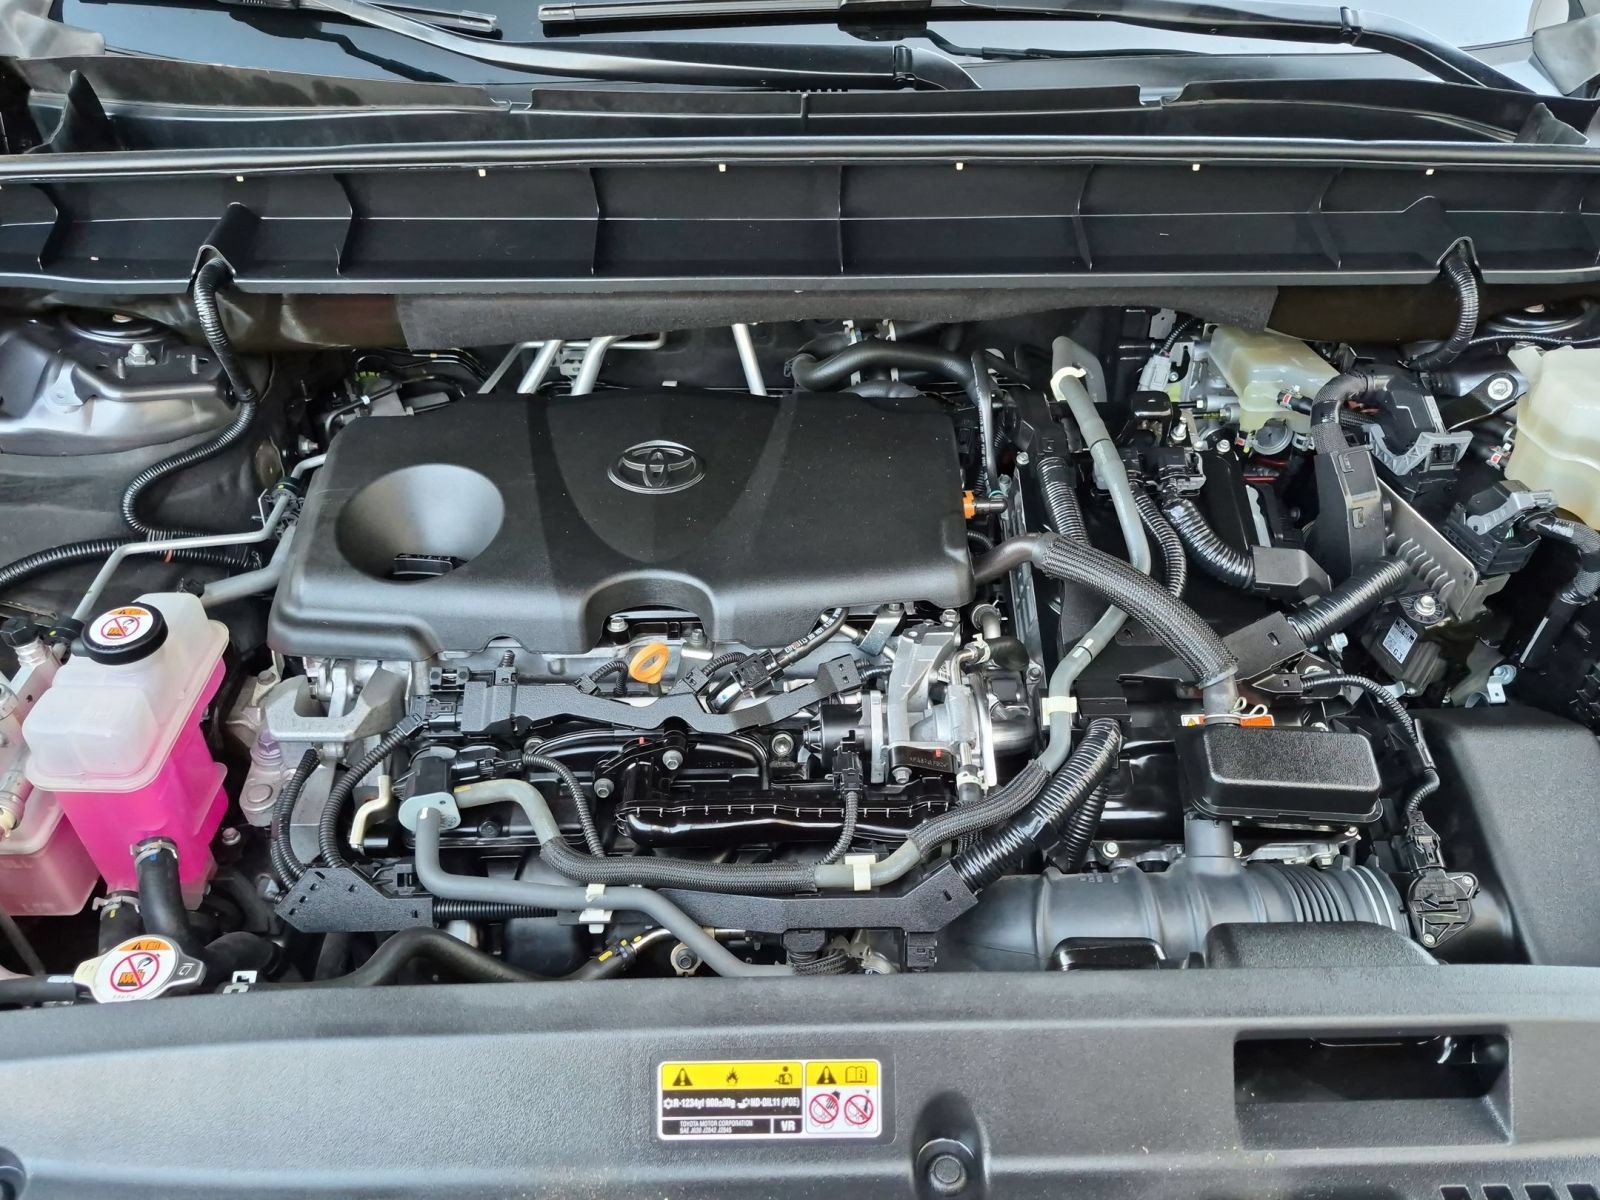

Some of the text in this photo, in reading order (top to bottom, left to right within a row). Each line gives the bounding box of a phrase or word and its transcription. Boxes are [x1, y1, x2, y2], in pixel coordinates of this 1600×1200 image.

[673, 1098, 704, 1109] R-1234yf
[718, 1119, 753, 1127] CORPORATION
[781, 1120, 796, 1132] VR
